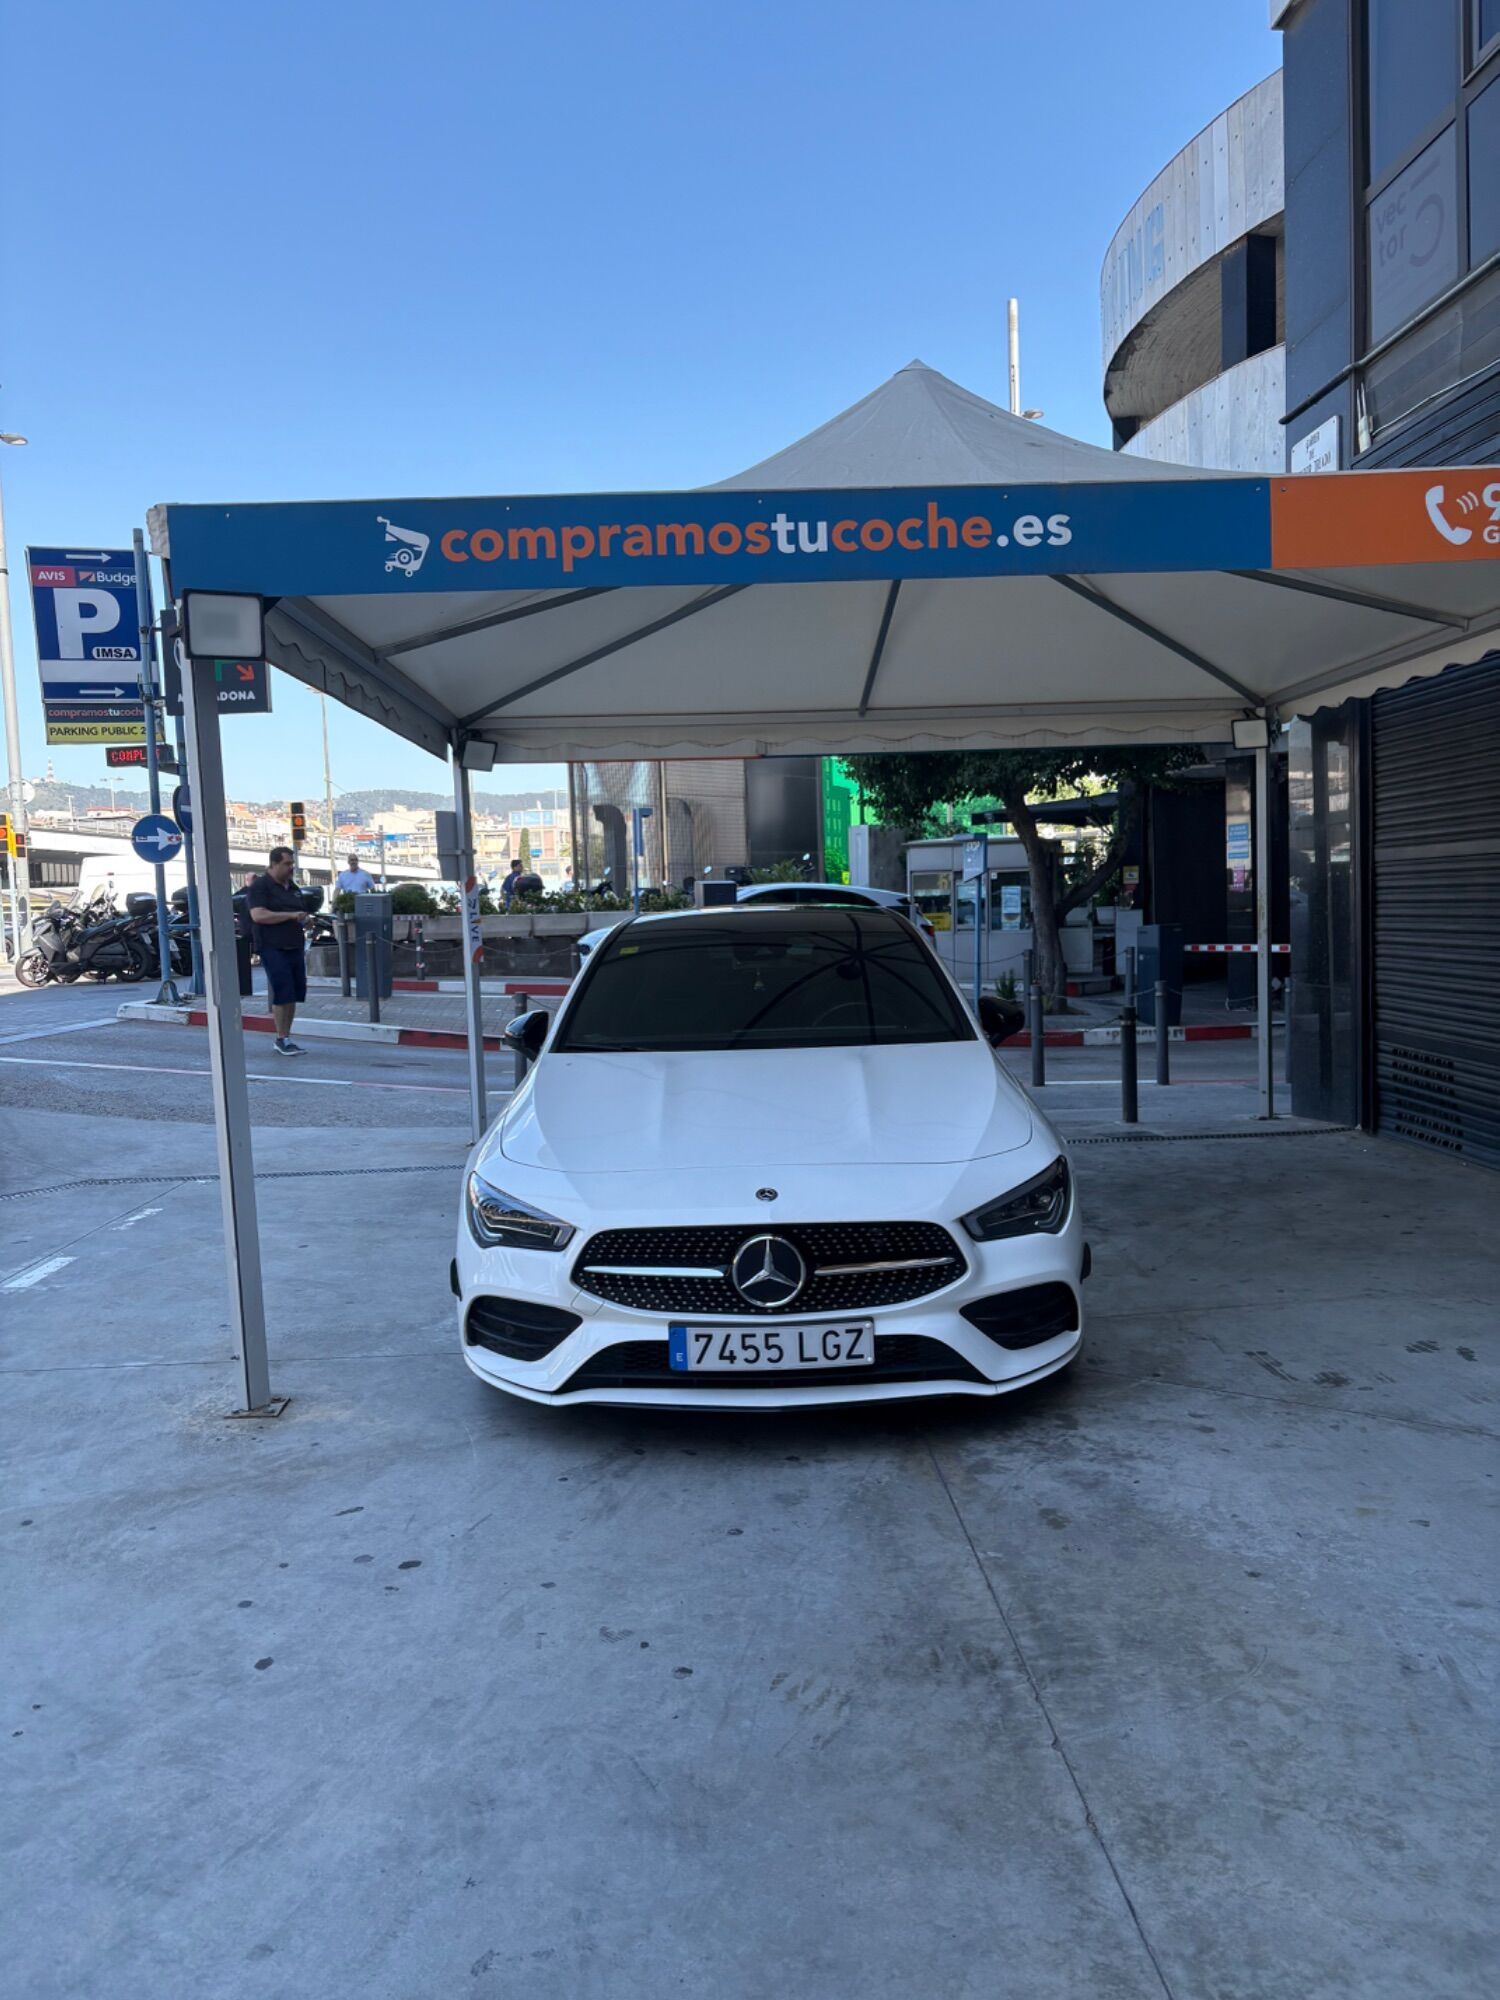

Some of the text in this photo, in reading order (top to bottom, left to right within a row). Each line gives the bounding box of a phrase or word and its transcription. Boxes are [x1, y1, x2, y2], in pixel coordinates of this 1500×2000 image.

[440, 502, 1072, 572] compramostucoche.es
[37, 571, 66, 581] AVIS
[96, 571, 137, 586] Budge
[53, 587, 121, 659] P
[96, 647, 135, 659] IMSA
[49, 726, 99, 736] PARKING
[101, 726, 138, 735] PUBLIC
[111, 748, 161, 763] COMPLT
[694, 1328, 865, 1365] 7455 LGZ
